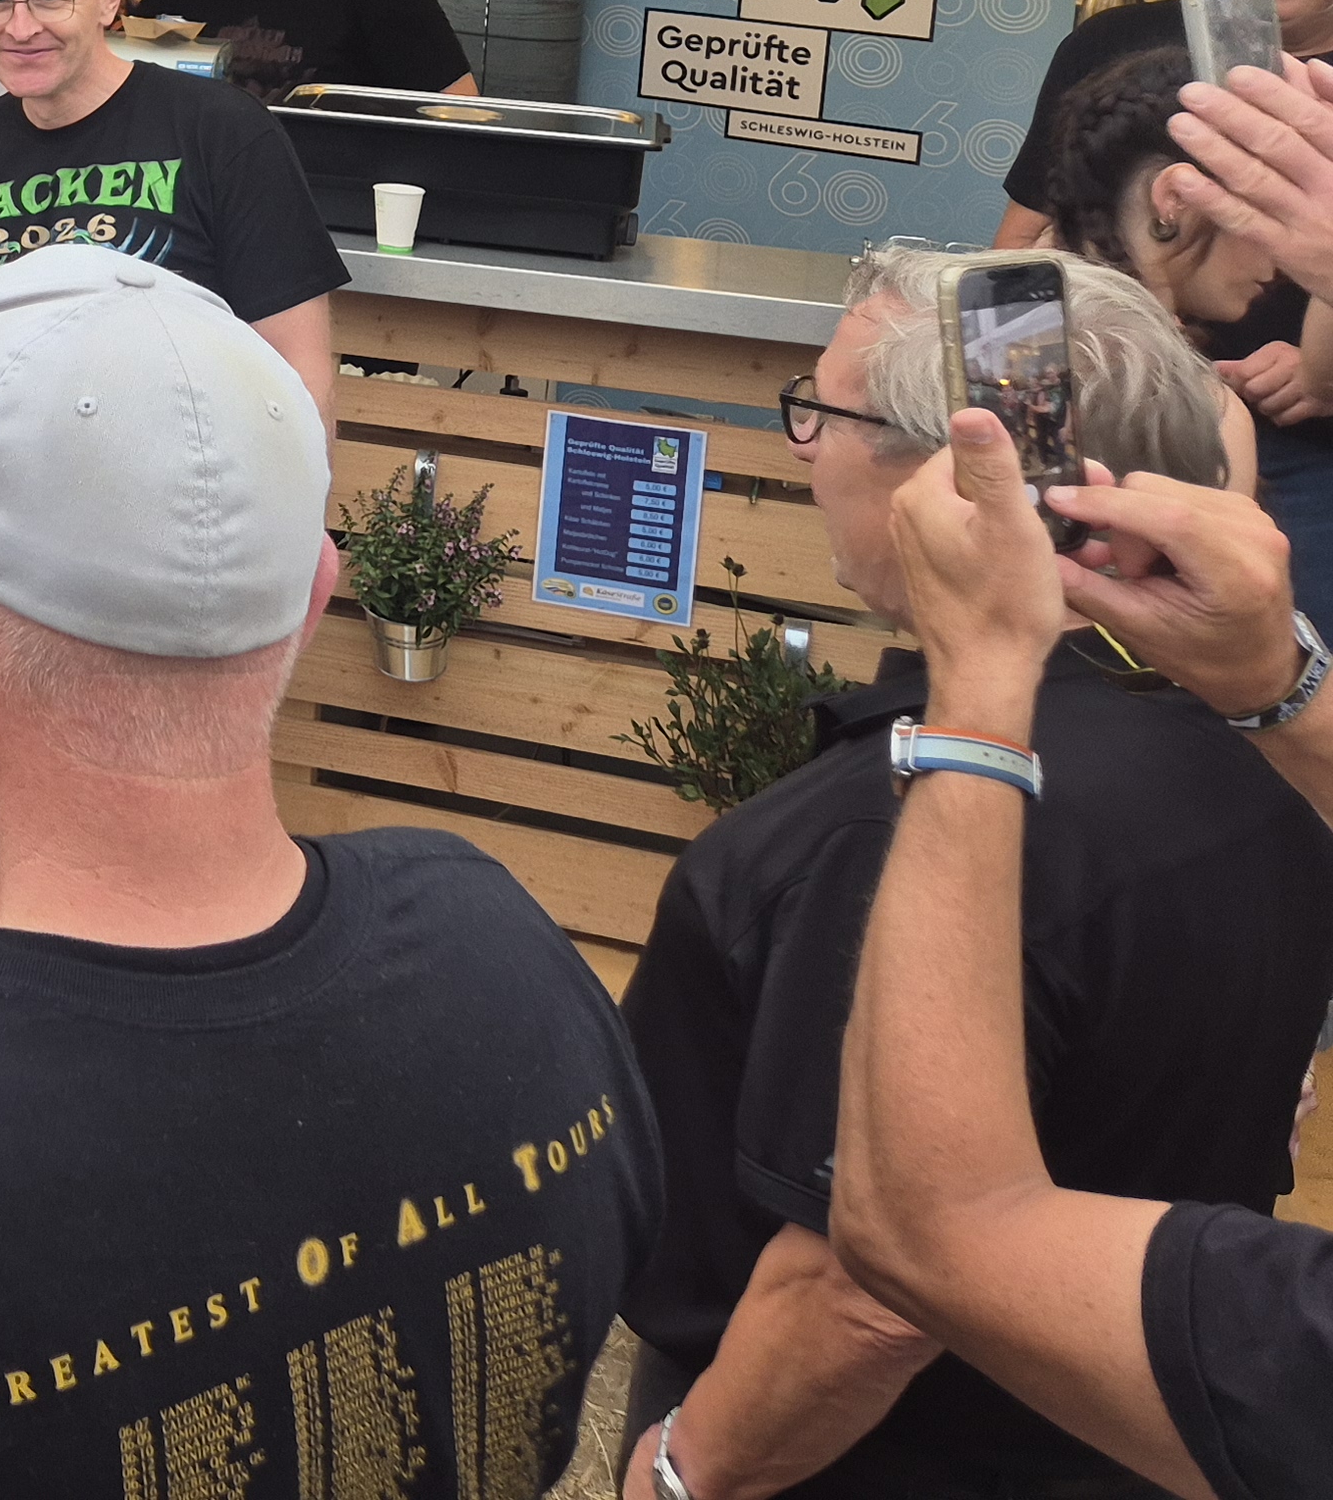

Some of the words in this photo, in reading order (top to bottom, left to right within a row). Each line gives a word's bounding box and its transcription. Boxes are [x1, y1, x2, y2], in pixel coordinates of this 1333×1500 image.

[657, 25, 812, 67] Geprüfte
[661, 60, 801, 100] Qualität
[740, 120, 906, 152] SCHLESWIG-HOLSTEIN
[913, 101, 1027, 176] 60
[768, 152, 889, 226] 60
[296, 1237, 359, 1288] OF
[397, 1182, 485, 1247] ALL
[513, 1093, 615, 1192] TOURS
